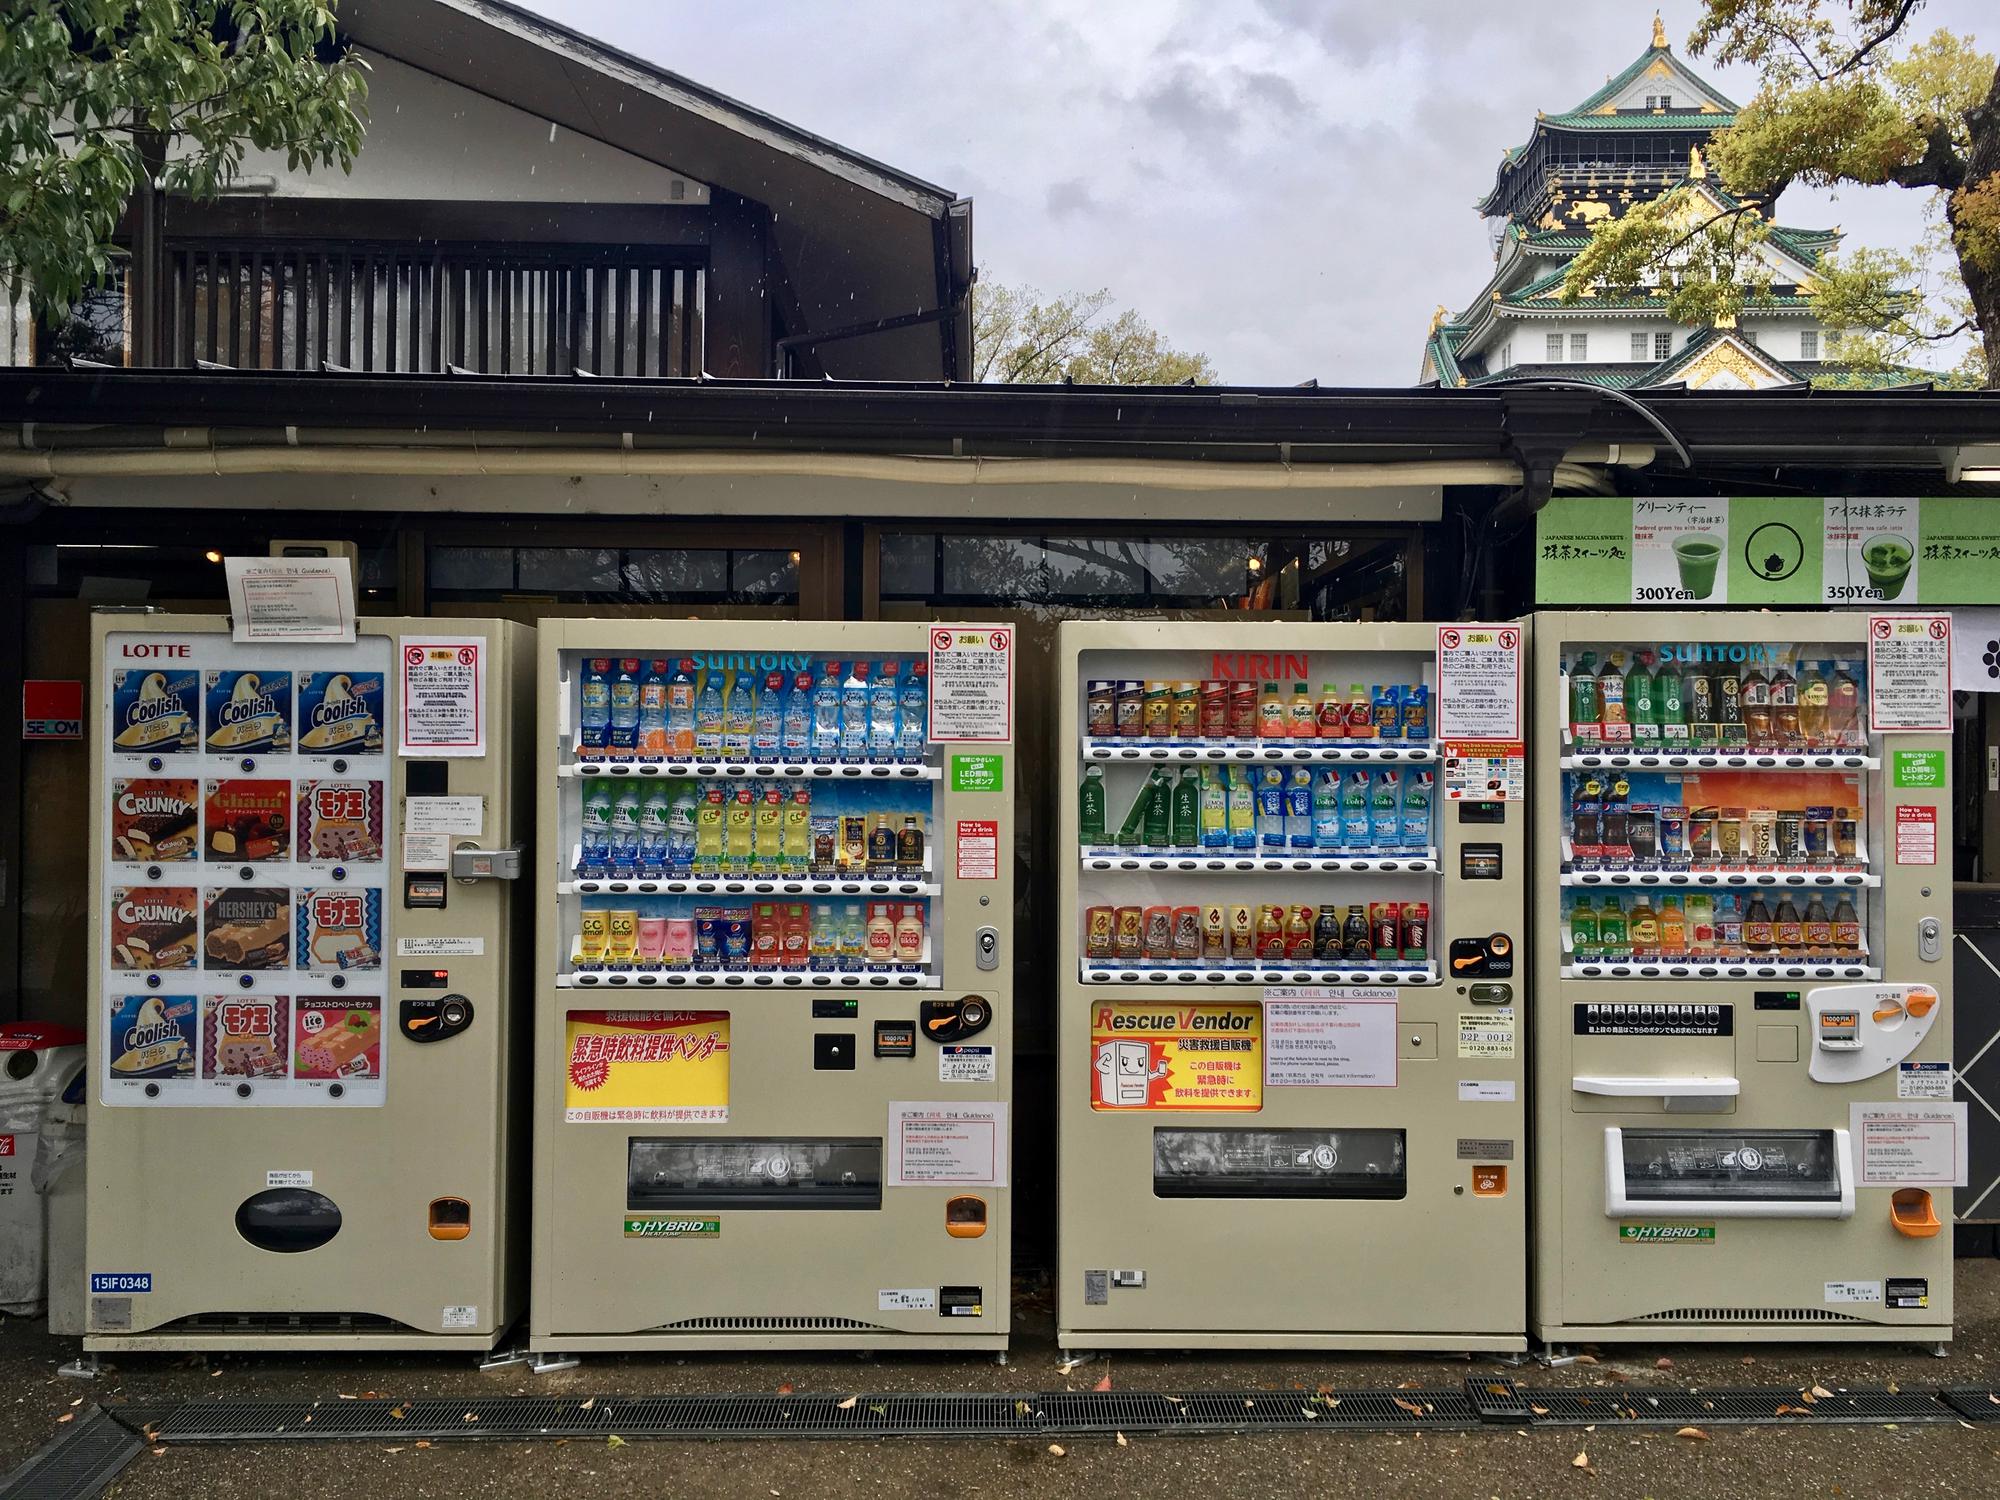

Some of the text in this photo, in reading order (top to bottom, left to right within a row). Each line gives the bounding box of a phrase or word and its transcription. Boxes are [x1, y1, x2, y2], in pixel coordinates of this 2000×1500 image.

[1636, 501, 1706, 513] グリーンティー
[1828, 505, 1907, 518] アイス抹茶ラテ
[1542, 545, 1626, 560] 抹茶スイーツ処
[1636, 586, 1694, 600] 300Yen
[1827, 586, 1883, 599] 350Yen
[1898, 625, 1923, 633] お願い
[959, 635, 984, 644] お願い
[1467, 634, 1493, 643] お願い
[123, 645, 190, 657] LOTTE
[430, 651, 453, 659] お願い
[1212, 655, 1308, 680] KIRIN
[127, 694, 181, 726] Coolish
[219, 695, 274, 727] Coolish
[312, 696, 366, 727] Coolish
[27, 721, 79, 734] SECOM
[119, 793, 189, 816] CRUNKY
[215, 793, 284, 809] Ghana
[318, 790, 364, 818] モナ王
[1086, 792, 1097, 815] 生茶
[1153, 792, 1164, 815] 生茶
[1180, 793, 1192, 816] 生茶
[1761, 824, 1770, 856] BOSS
[117, 902, 188, 924] CRUNKY
[219, 902, 275, 917] HERSHEY'S
[315, 898, 361, 927] モナ王
[304, 1000, 373, 1009] チョコストロベリーモナカ
[224, 1005, 270, 1033] モナ王
[305, 1016, 322, 1027] ice
[1094, 1008, 1176, 1031] Rescue
[1178, 1008, 1253, 1031] Vendor
[124, 1019, 178, 1051] Coolish
[1589, 1027, 1718, 1035] 最上段の商品はこちらのボタンでもお求めになれます
[571, 1032, 730, 1063] 緊急時飲料提供ベンダー
[1178, 1039, 1252, 1051] 災害救援自販機
[1190, 1061, 1241, 1071] この自販機は
[1197, 1076, 1234, 1085] 緊急時に
[567, 1110, 729, 1121] この自販機は緊急時に飲料が提供できます。
[640, 1222, 704, 1235] HYBRID
[1636, 1227, 1699, 1241] HYBRID
[94, 1277, 149, 1289] 15IF0348
